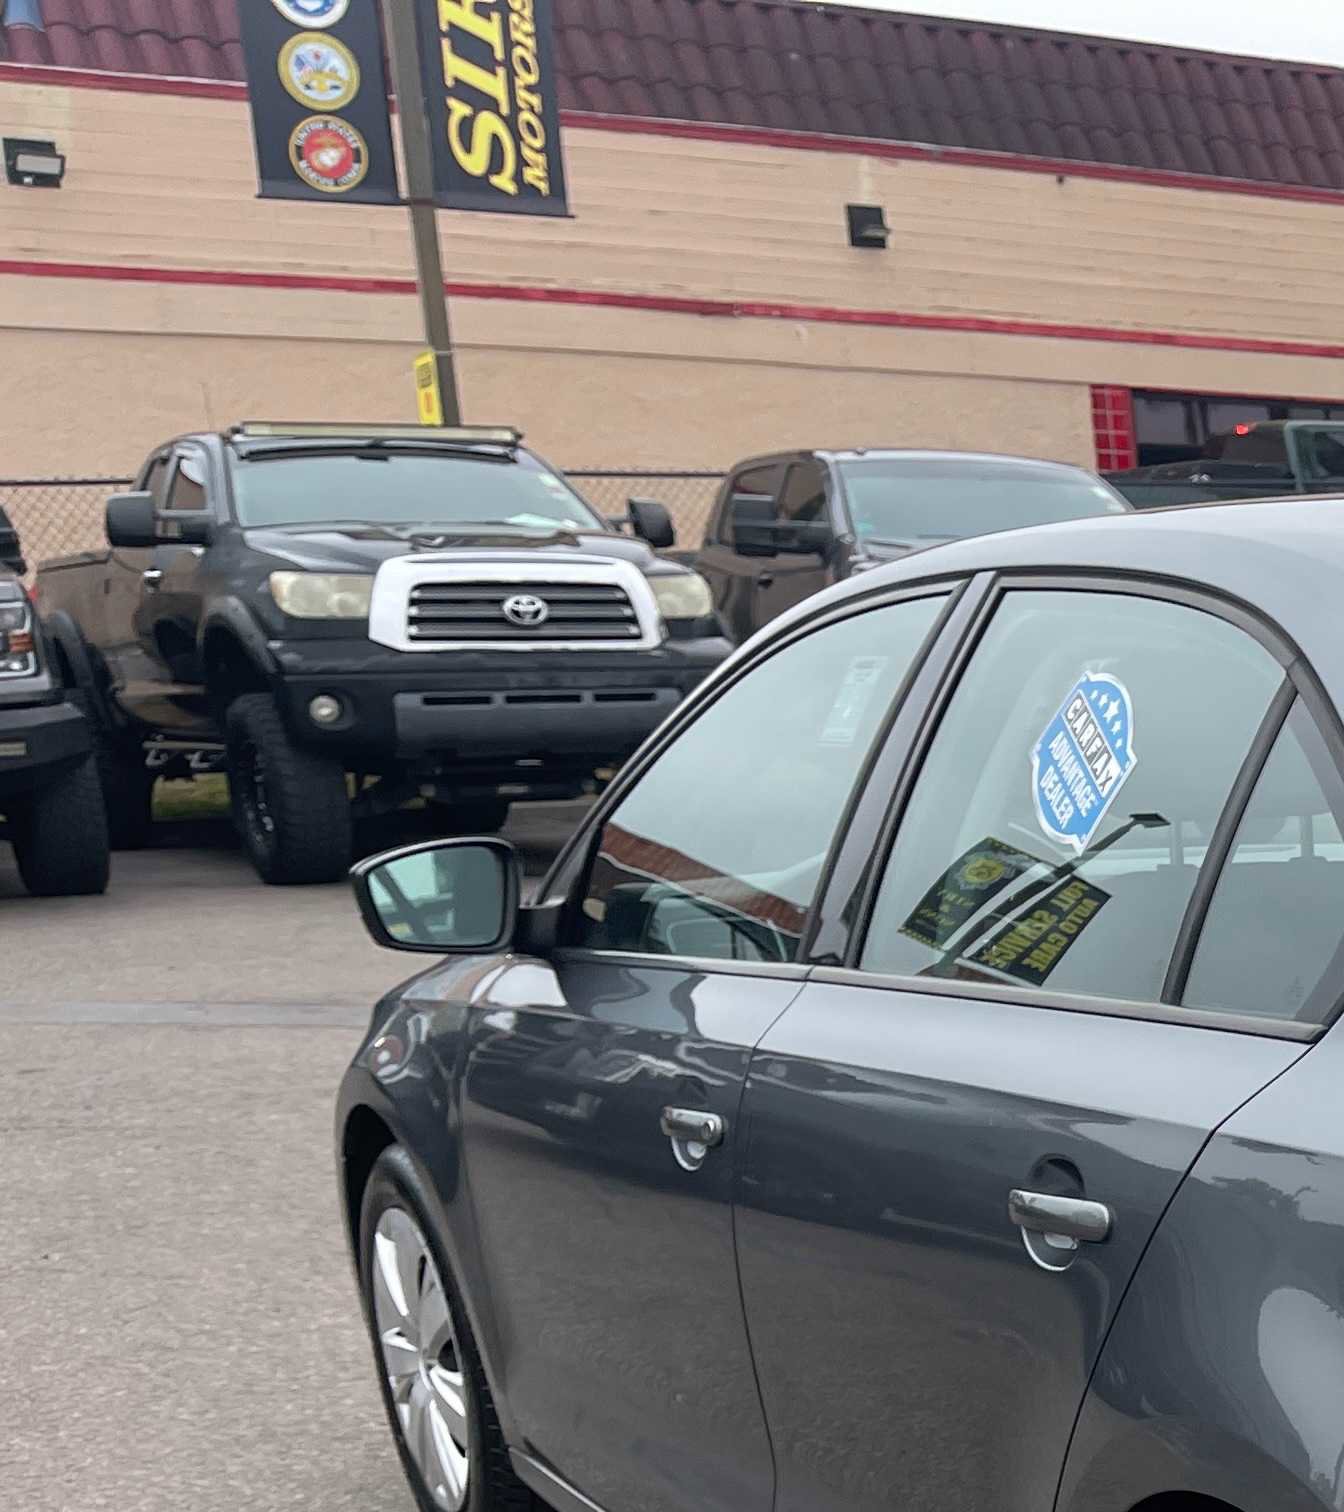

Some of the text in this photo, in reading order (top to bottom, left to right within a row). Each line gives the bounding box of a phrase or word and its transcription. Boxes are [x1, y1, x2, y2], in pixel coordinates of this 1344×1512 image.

[1048, 731, 1099, 818] ADVANTAGE
[1066, 697, 1122, 798] CARFAX
[1040, 765, 1075, 829] DEALER
